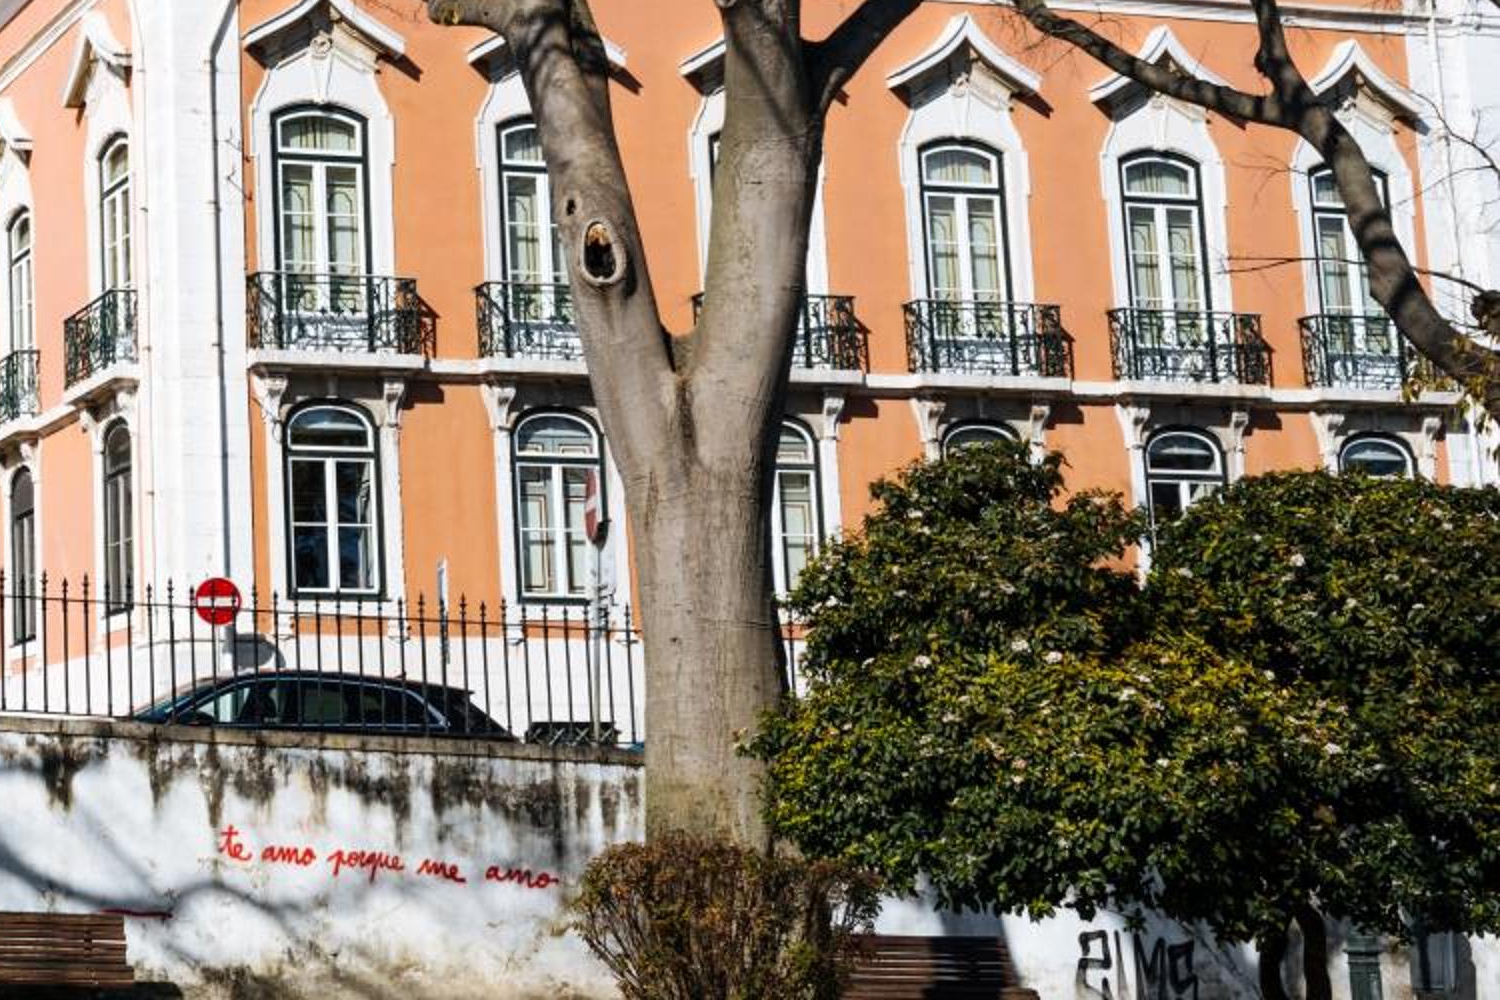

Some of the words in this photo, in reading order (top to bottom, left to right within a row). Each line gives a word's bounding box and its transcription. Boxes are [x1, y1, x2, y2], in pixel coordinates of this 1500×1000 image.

[219, 825, 252, 861] te
[261, 845, 316, 866] amo
[417, 859, 466, 884] me
[485, 865, 559, 889] amo
